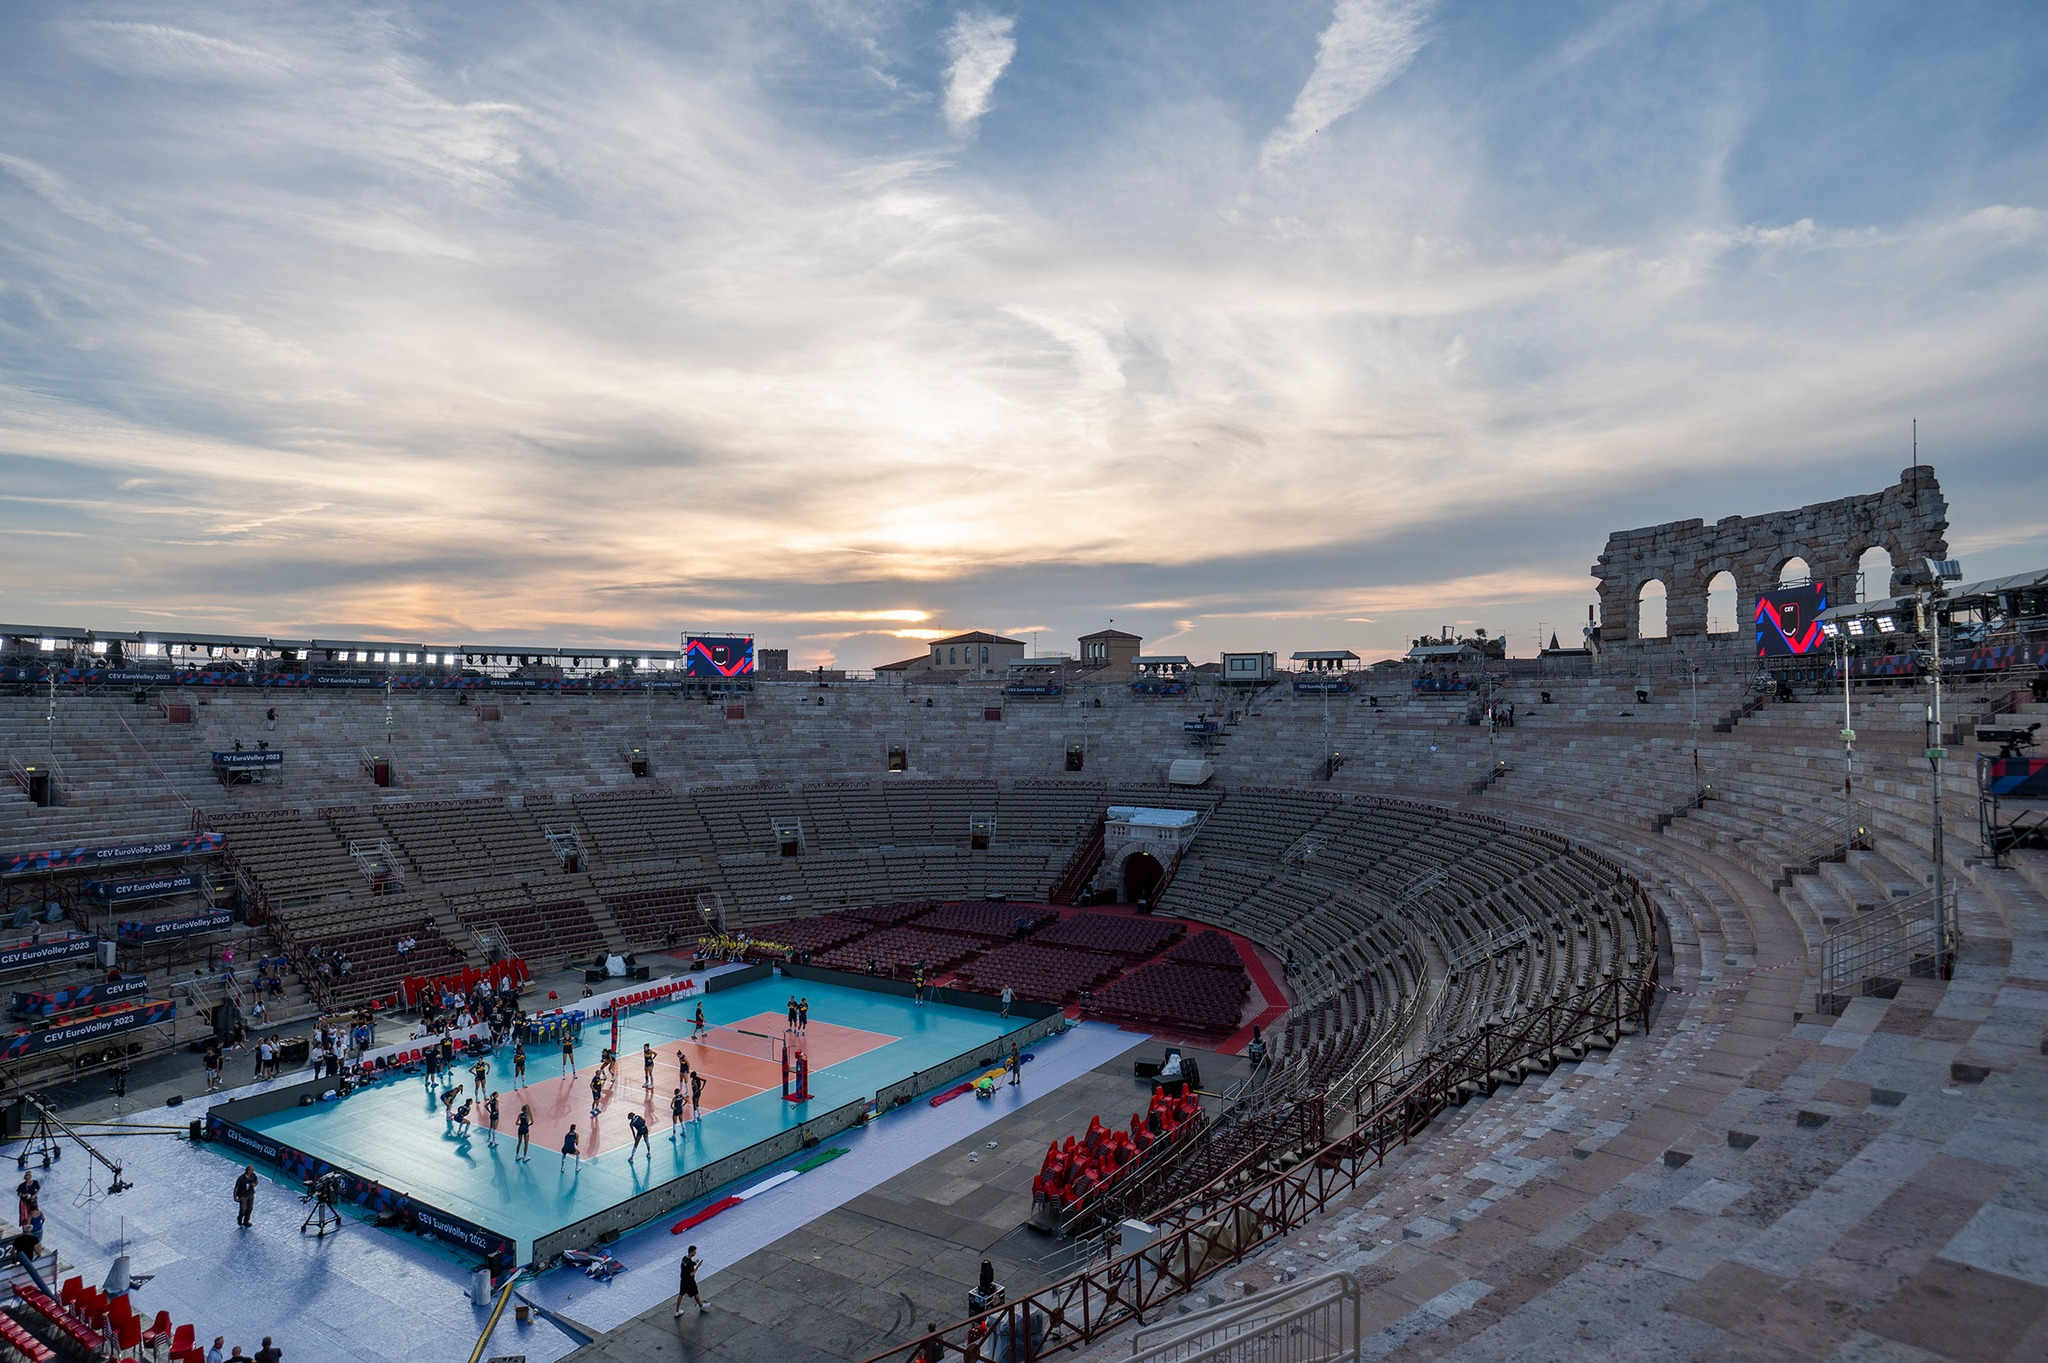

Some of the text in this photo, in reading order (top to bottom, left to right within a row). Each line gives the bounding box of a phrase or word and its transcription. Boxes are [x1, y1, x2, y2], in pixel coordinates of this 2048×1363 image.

[114, 846, 152, 856] EuroVolley
[116, 878, 191, 894] CEV EuroVolley 2023
[155, 916, 230, 933] CEV EuroVolley 2023
[1, 942, 90, 963] CEV EuroVolley 2023
[106, 984, 124, 994] CEV
[44, 1015, 134, 1043] CEV EuroVolley 2023
[228, 1129, 276, 1156] CEV EuroVolley 2023
[418, 1212, 487, 1248] CEV EuroVolley 2023
